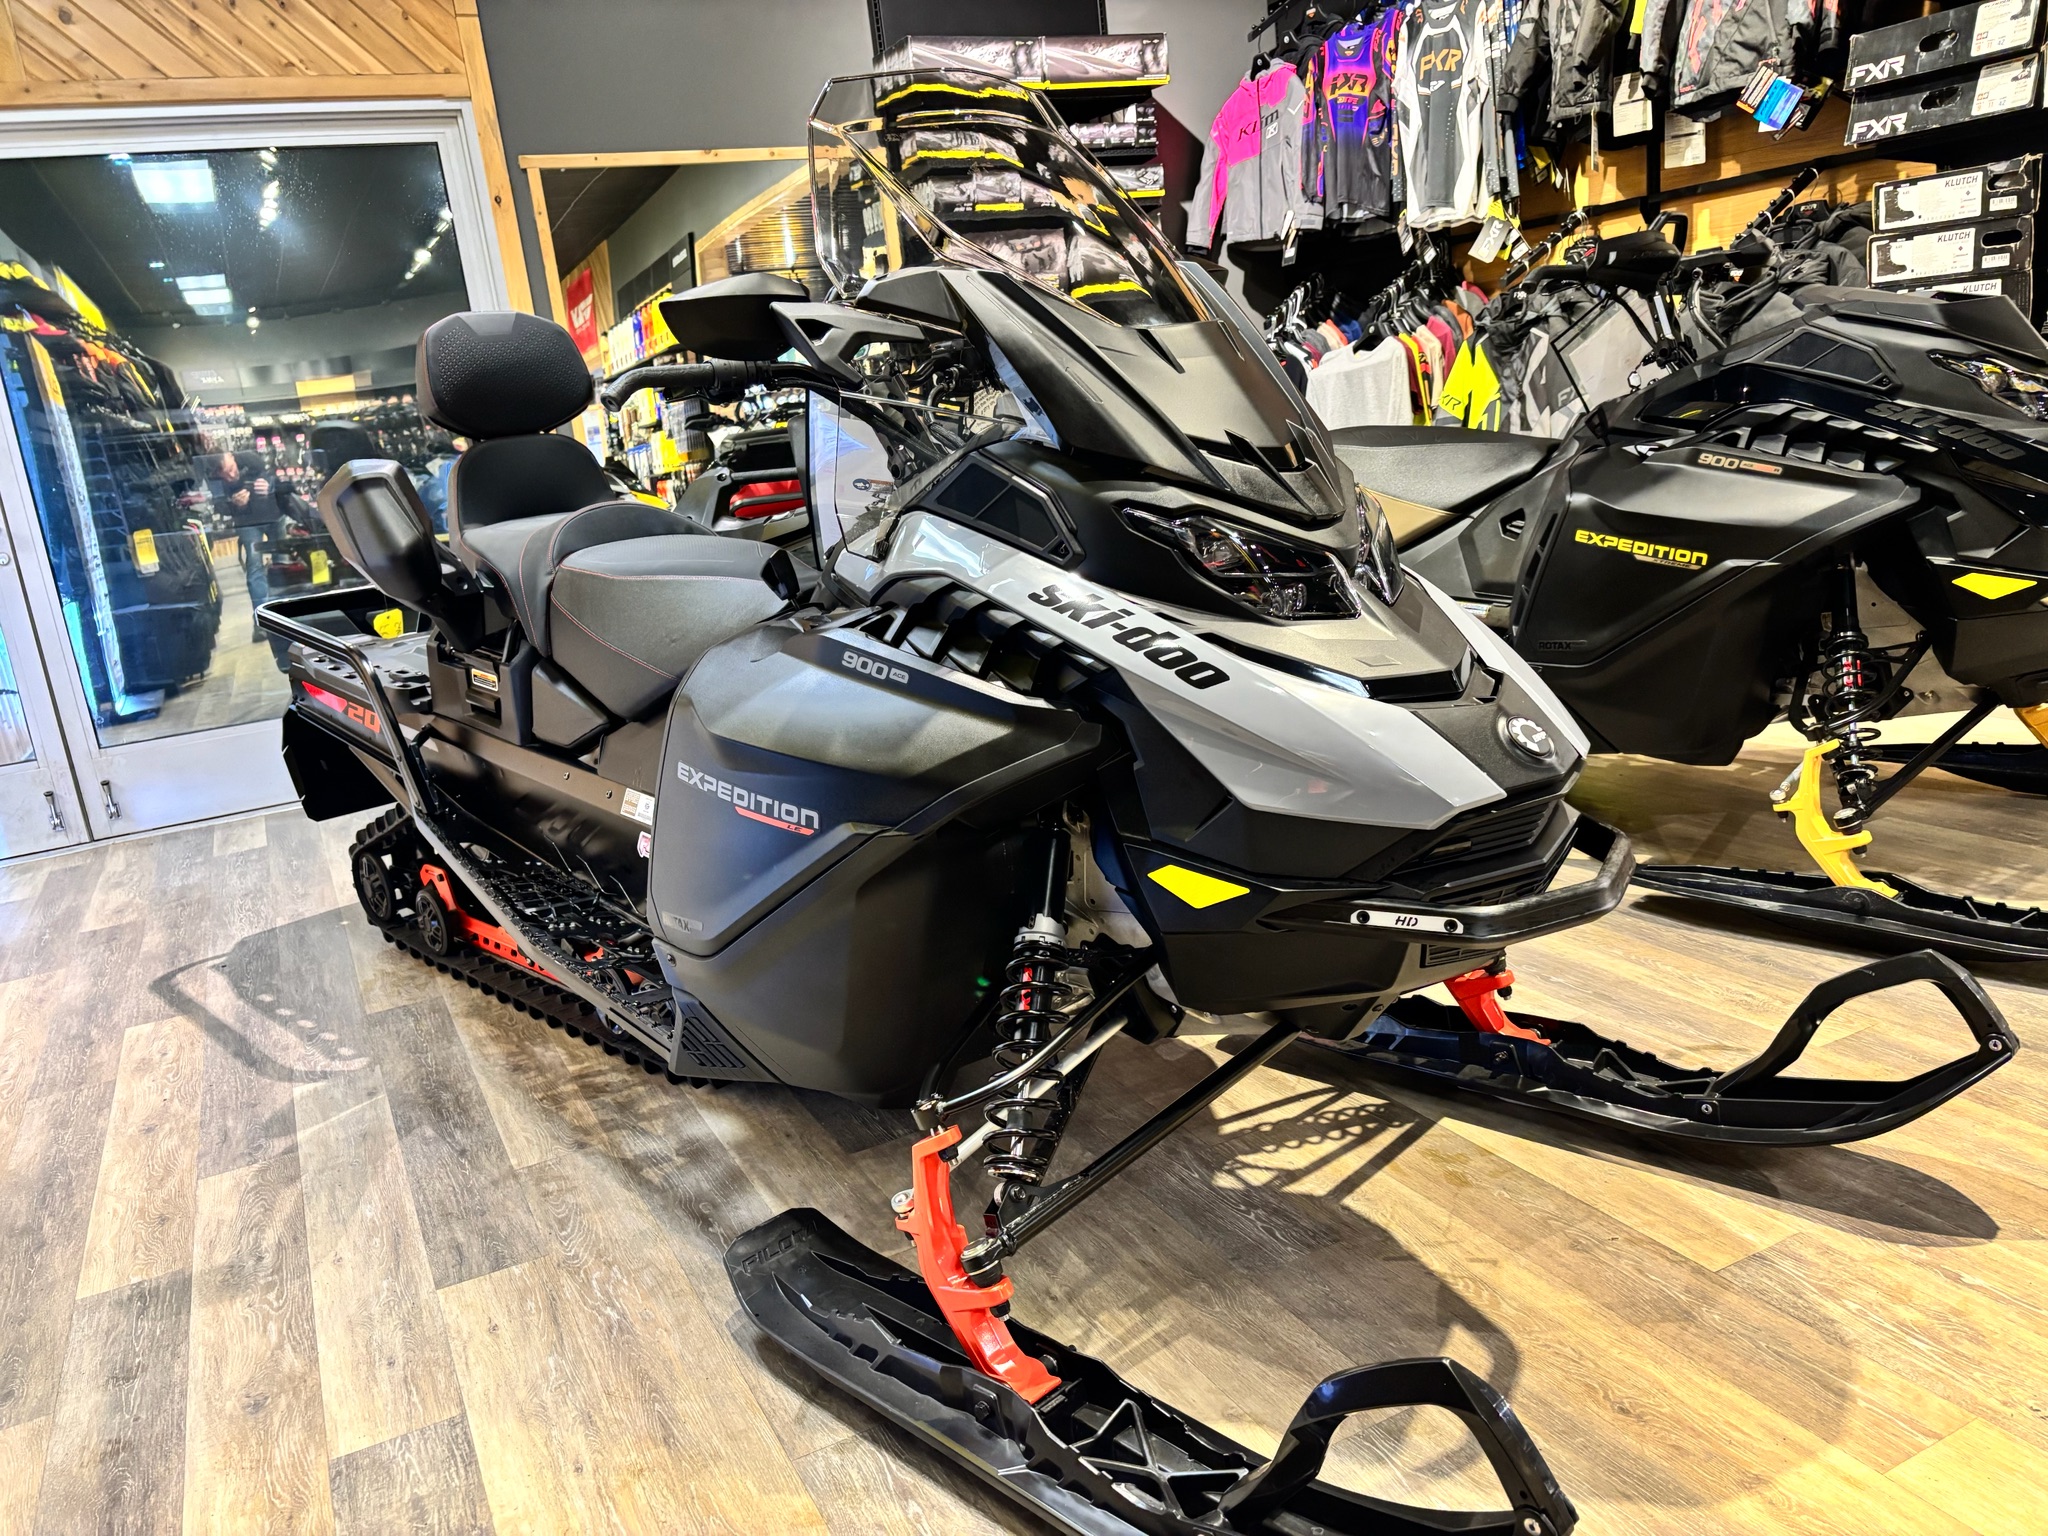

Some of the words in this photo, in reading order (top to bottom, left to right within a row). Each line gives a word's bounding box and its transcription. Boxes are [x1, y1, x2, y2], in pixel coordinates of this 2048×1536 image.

[1420, 49, 1462, 80] FXR
[1850, 54, 1906, 86] FXR
[1330, 73, 1368, 96] FXR
[1851, 112, 1908, 142] FXR
[1944, 175, 1979, 188] KLUTCH
[1801, 203, 1817, 213] FXR
[1478, 219, 1503, 257] FXR
[1937, 231, 1971, 243] KLUTCH
[1962, 282, 1997, 294] KLUTCH
[1557, 385, 1576, 407] FX
[1865, 402, 2026, 460] ski-doo
[1698, 453, 1739, 469] 900
[1574, 529, 1708, 566] EXPEDITION
[1653, 558, 1692, 569] XTREME
[1027, 584, 1231, 690] ski-doo
[1538, 641, 1572, 651] ROTAX
[841, 650, 889, 680] 900
[892, 671, 907, 681] ACE
[677, 761, 819, 830] EXPEDITION
[786, 824, 803, 833] LE
[1394, 916, 1419, 927] HD
